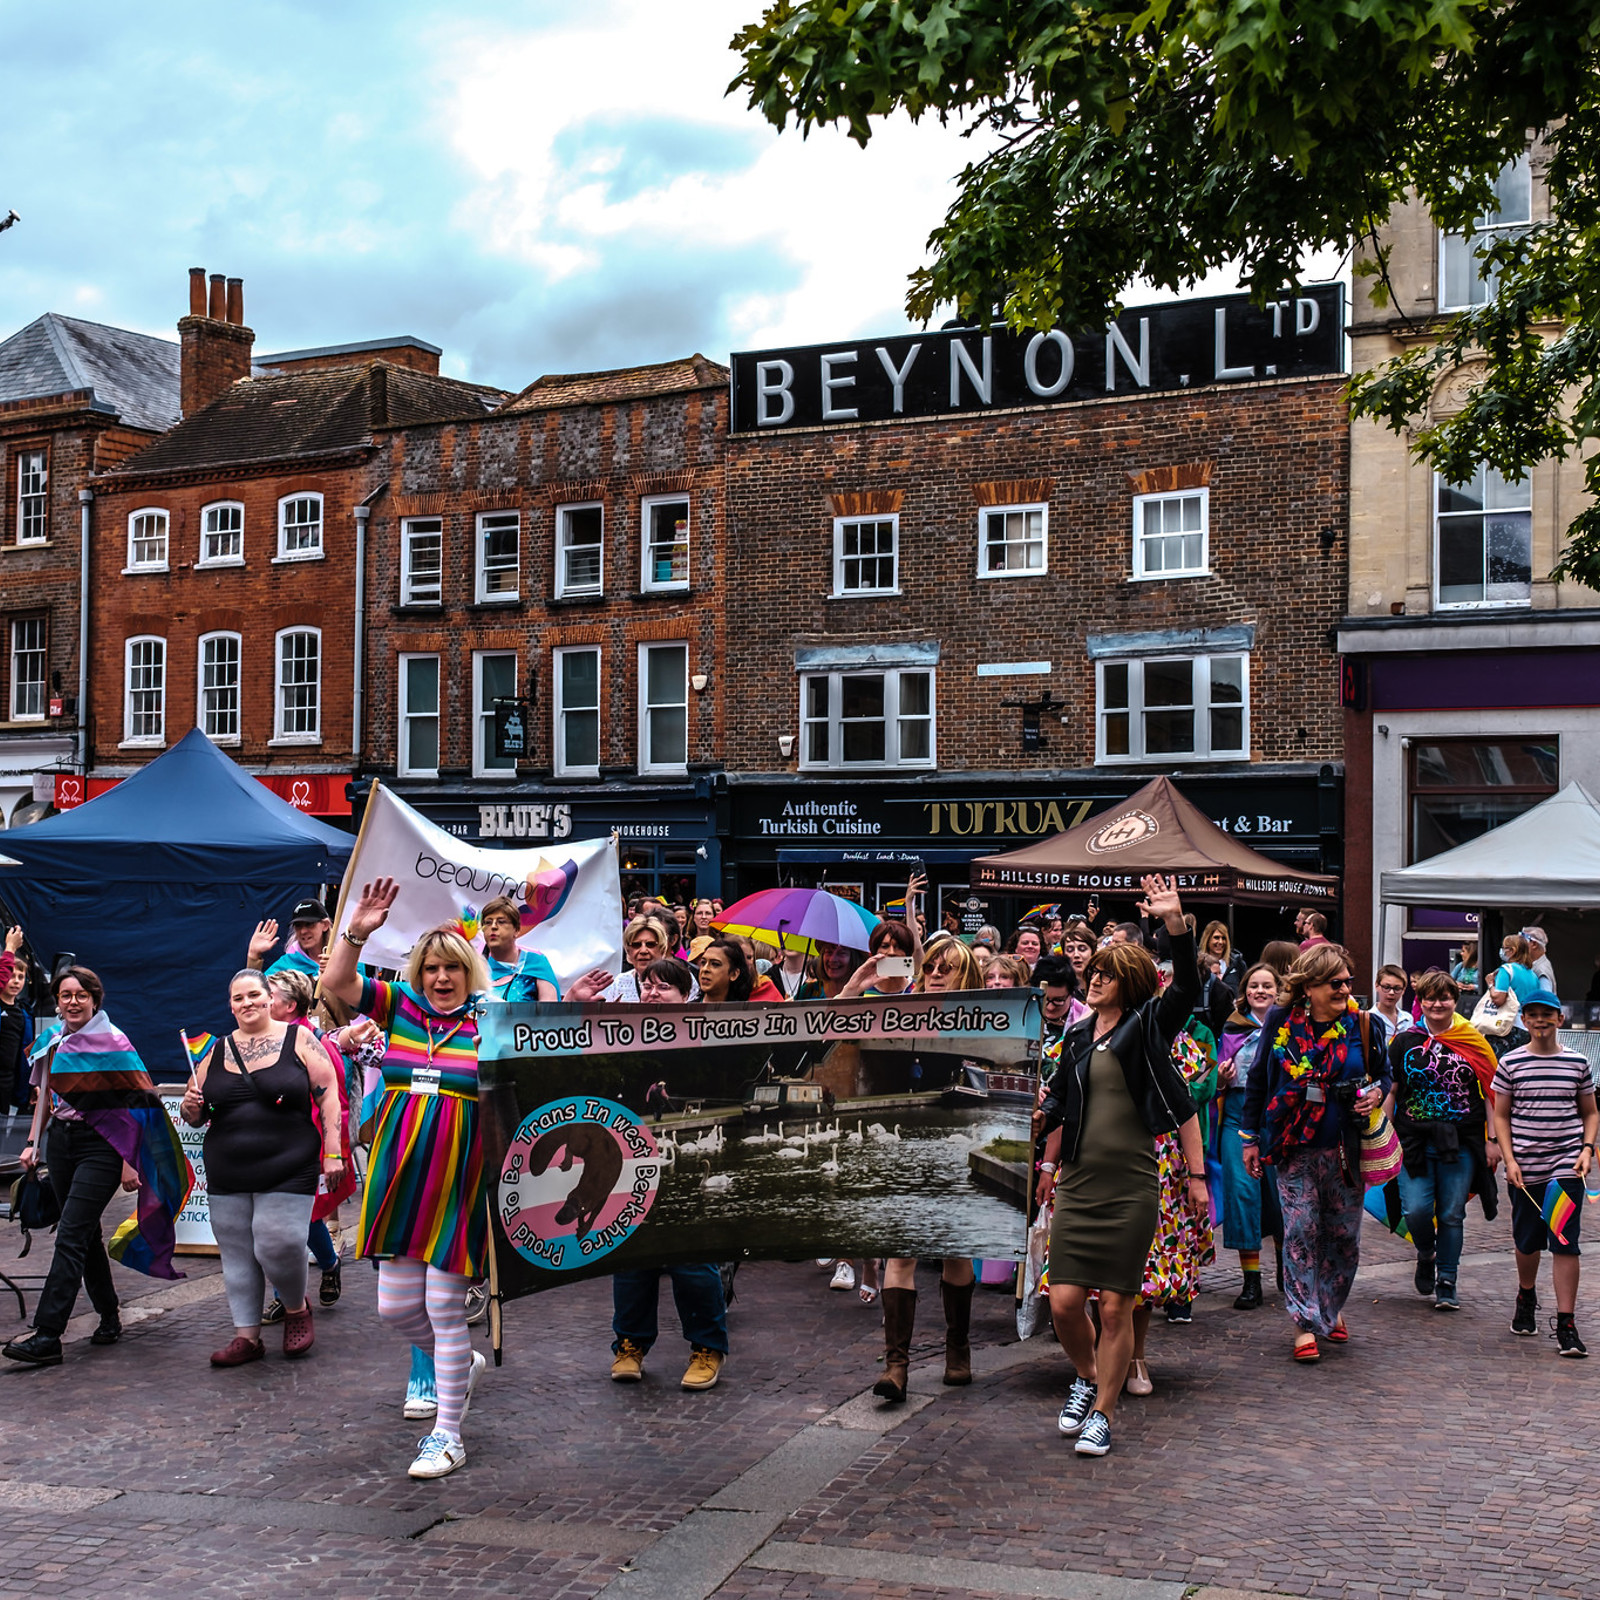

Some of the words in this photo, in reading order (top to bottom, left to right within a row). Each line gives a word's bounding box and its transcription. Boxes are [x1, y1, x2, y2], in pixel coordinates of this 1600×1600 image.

[782, 800, 857, 816] Authentic
[478, 804, 572, 838] BLUE'S
[759, 818, 818, 834] Turkish
[822, 818, 881, 834] Cuisine
[1233, 815, 1251, 832] &
[1257, 815, 1292, 832] Bar
[453, 825, 468, 835] BAR
[610, 825, 669, 837] SMOKEHOUSE
[1001, 870, 1070, 885] HILLSIDE
[1078, 875, 1132, 887] HOUSE
[1245, 879, 1277, 892] HILLSIDE
[1279, 881, 1303, 893] HOUSE
[1303, 884, 1327, 896] HONEY
[1465, 912, 1478, 923] Ca
[514, 1020, 591, 1050] Proud
[600, 1020, 633, 1045] To
[641, 1019, 676, 1043] Be
[684, 1015, 759, 1041] Trans
[764, 1014, 796, 1037] In
[804, 1010, 875, 1034] West
[881, 1006, 1010, 1033] Berkshire
[583, 1100, 610, 1122] In
[516, 1104, 576, 1145] Trans
[503, 1154, 523, 1184] Be
[180, 1211, 207, 1222] STICK
[503, 1192, 520, 1226] To
[581, 1165, 657, 1254] Berkshire
[511, 1223, 564, 1266] Proud
